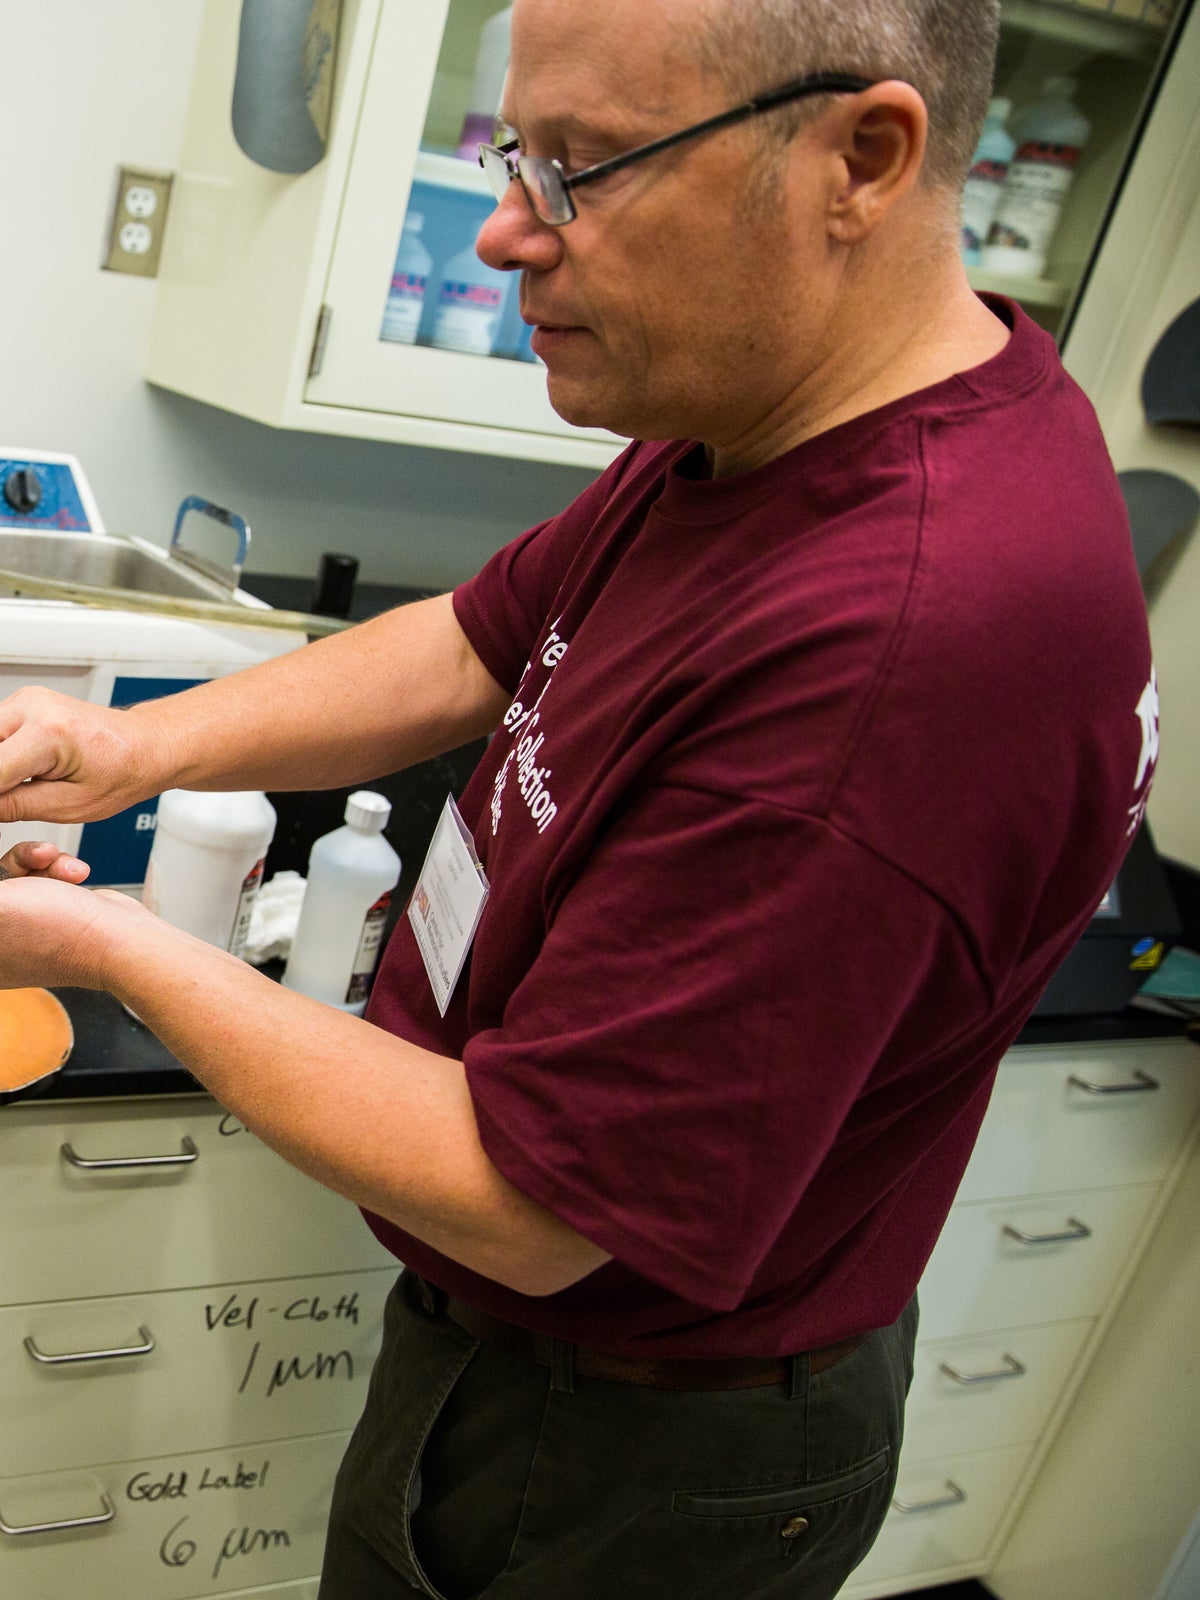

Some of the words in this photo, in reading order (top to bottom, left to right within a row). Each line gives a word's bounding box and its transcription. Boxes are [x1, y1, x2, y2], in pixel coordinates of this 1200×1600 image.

[126, 1470, 188, 1502] Gold
[198, 1460, 270, 1490] Label
[159, 1515, 197, 1567] 6
